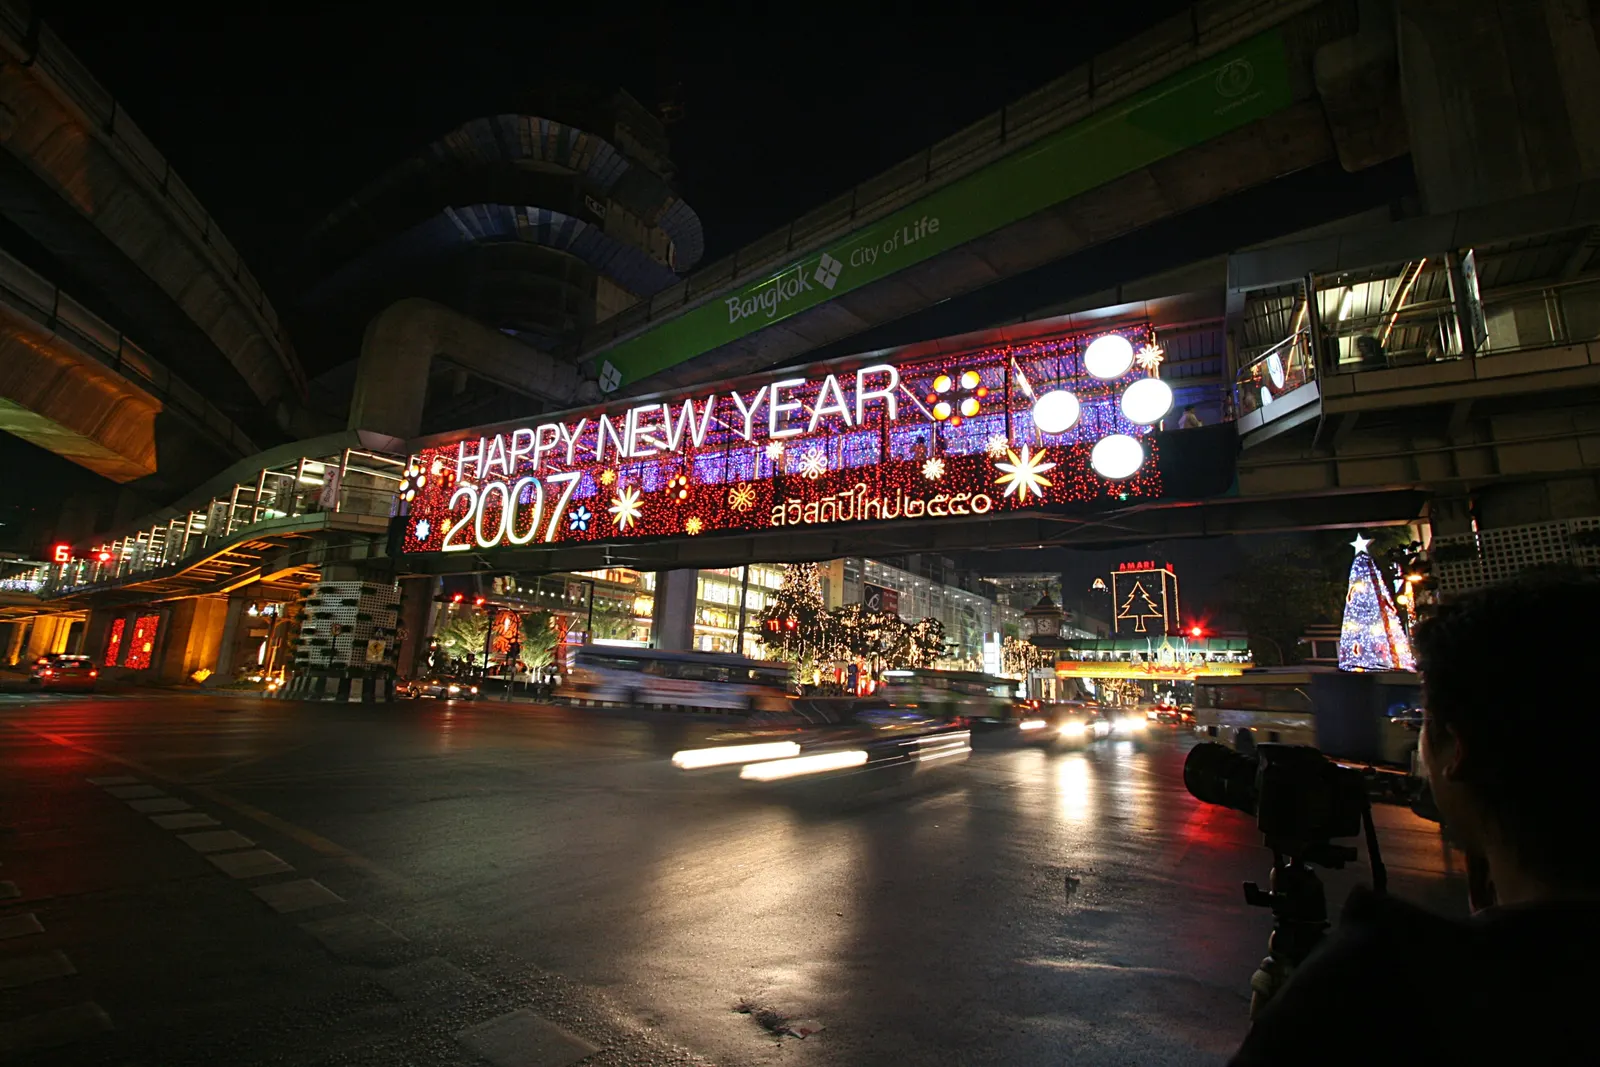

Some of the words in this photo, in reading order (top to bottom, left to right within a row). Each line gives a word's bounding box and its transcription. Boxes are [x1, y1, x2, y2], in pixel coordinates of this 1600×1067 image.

[850, 244, 880, 267] City
[883, 230, 900, 253] of
[903, 217, 940, 246] Life
[725, 265, 814, 324] Bangkok
[456, 418, 588, 482] HAPPY
[595, 394, 716, 459] NEW
[731, 363, 899, 441] YEAR
[441, 471, 582, 553] 2007
[54, 544, 70, 562] 6
[1119, 561, 1155, 570] AMARI
